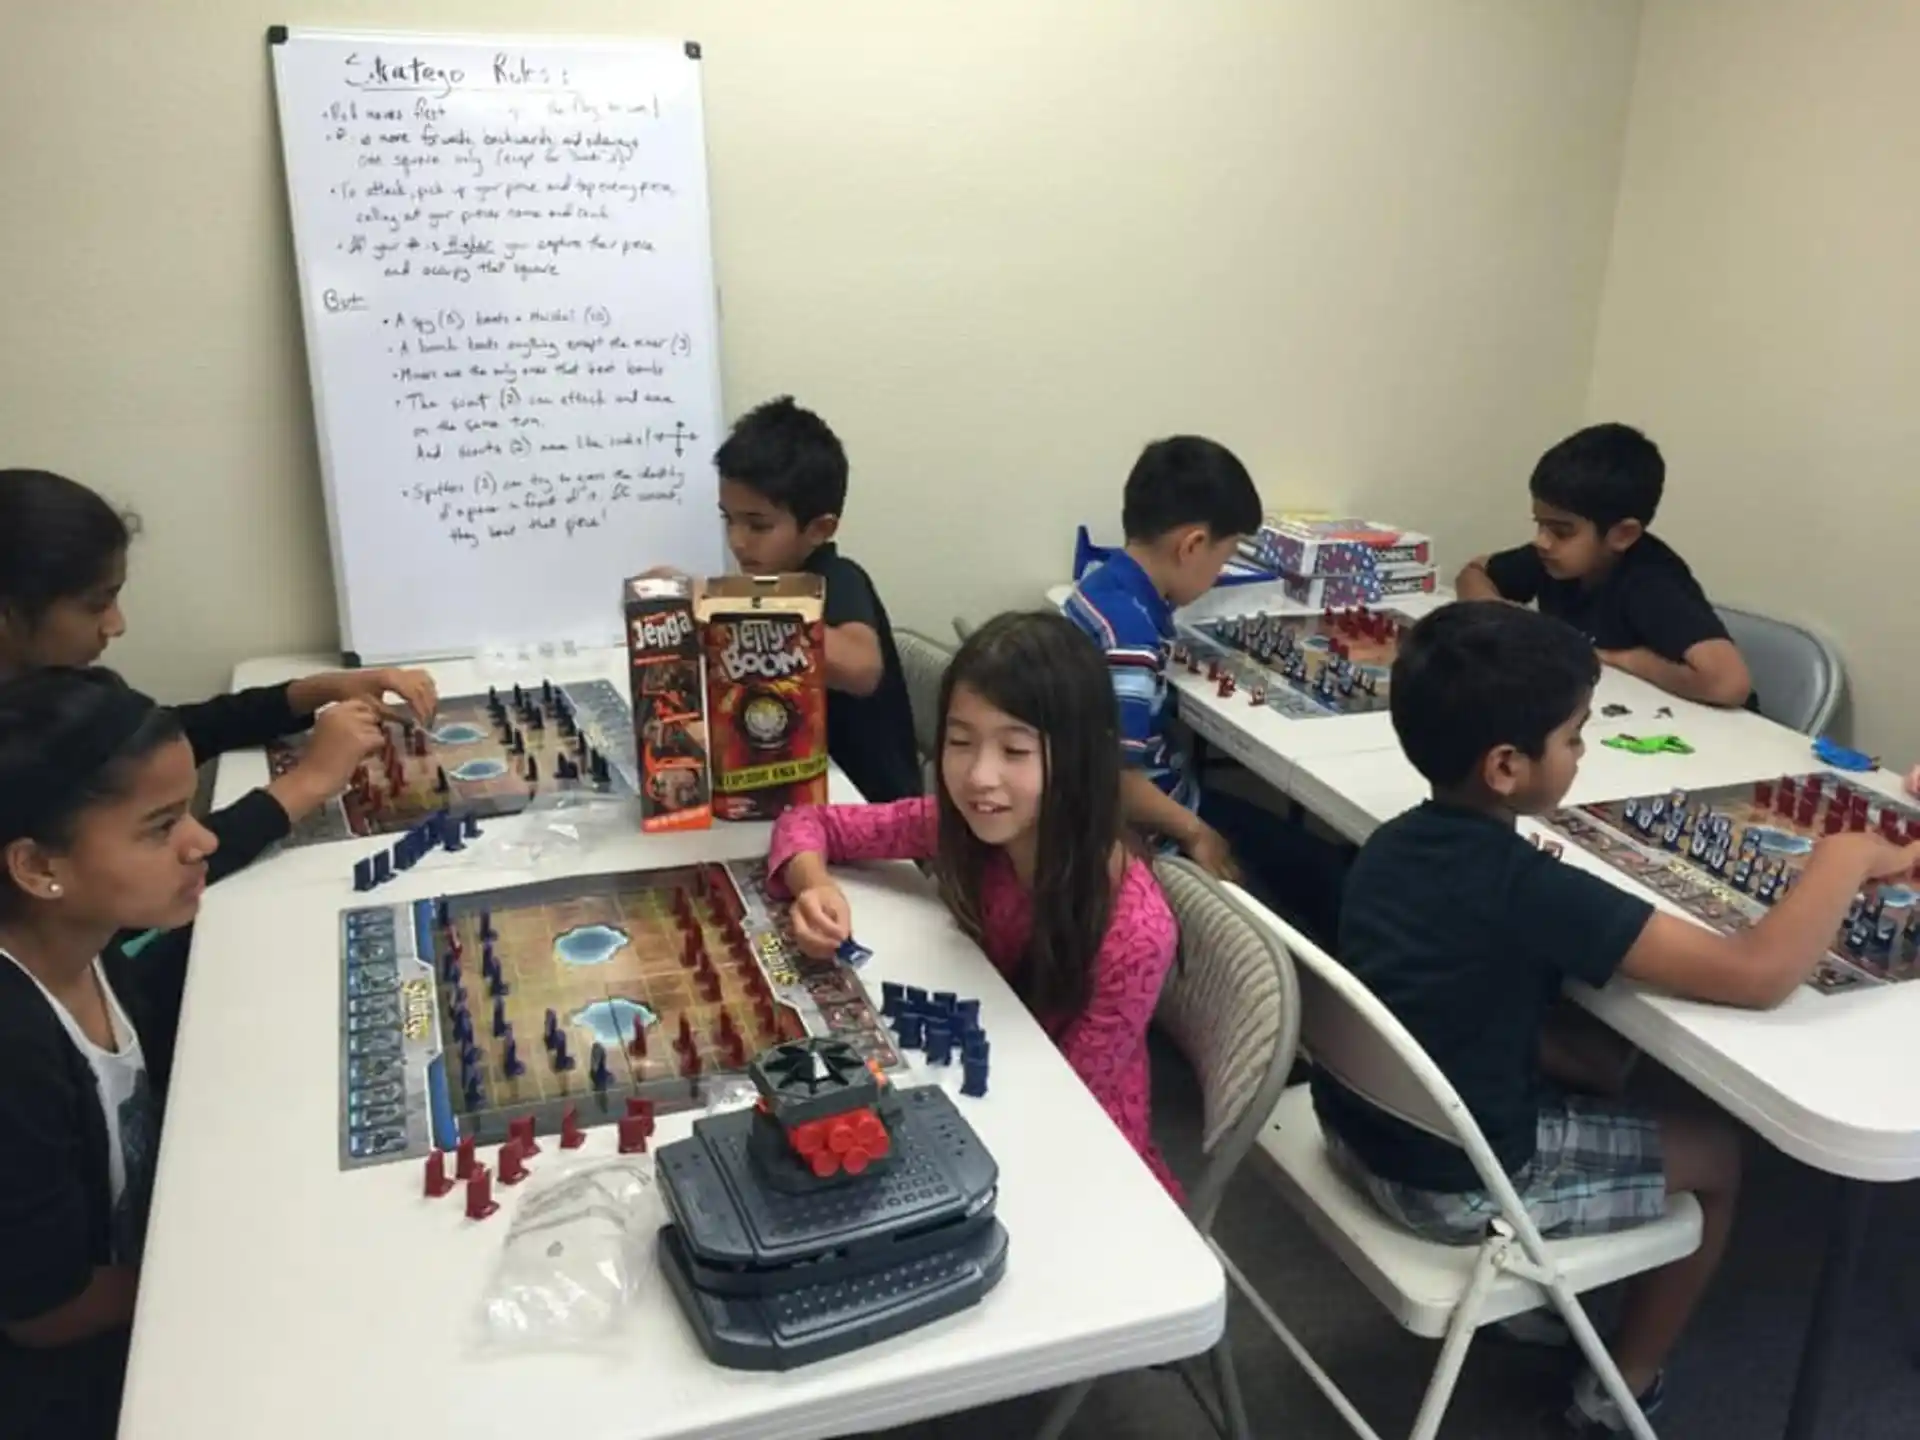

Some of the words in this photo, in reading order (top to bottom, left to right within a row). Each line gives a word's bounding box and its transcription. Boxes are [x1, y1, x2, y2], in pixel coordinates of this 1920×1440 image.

[547, 172, 572, 192] and
[355, 206, 401, 233] calling
[428, 210, 455, 229] your
[383, 259, 410, 277] and
[421, 265, 472, 284] occupy
[513, 262, 561, 283] square
[418, 336, 458, 353] bomb
[467, 336, 499, 350] beats
[443, 370, 463, 378] are
[468, 365, 488, 377] the
[405, 391, 439, 411] The
[614, 388, 639, 405] and
[412, 426, 430, 438] on
[436, 419, 458, 432] the
[464, 418, 500, 433] same
[416, 443, 443, 461] And
[449, 525, 480, 550] they
[527, 516, 557, 530] that
[632, 611, 694, 650] Jenga
[720, 647, 809, 682] BOOM
